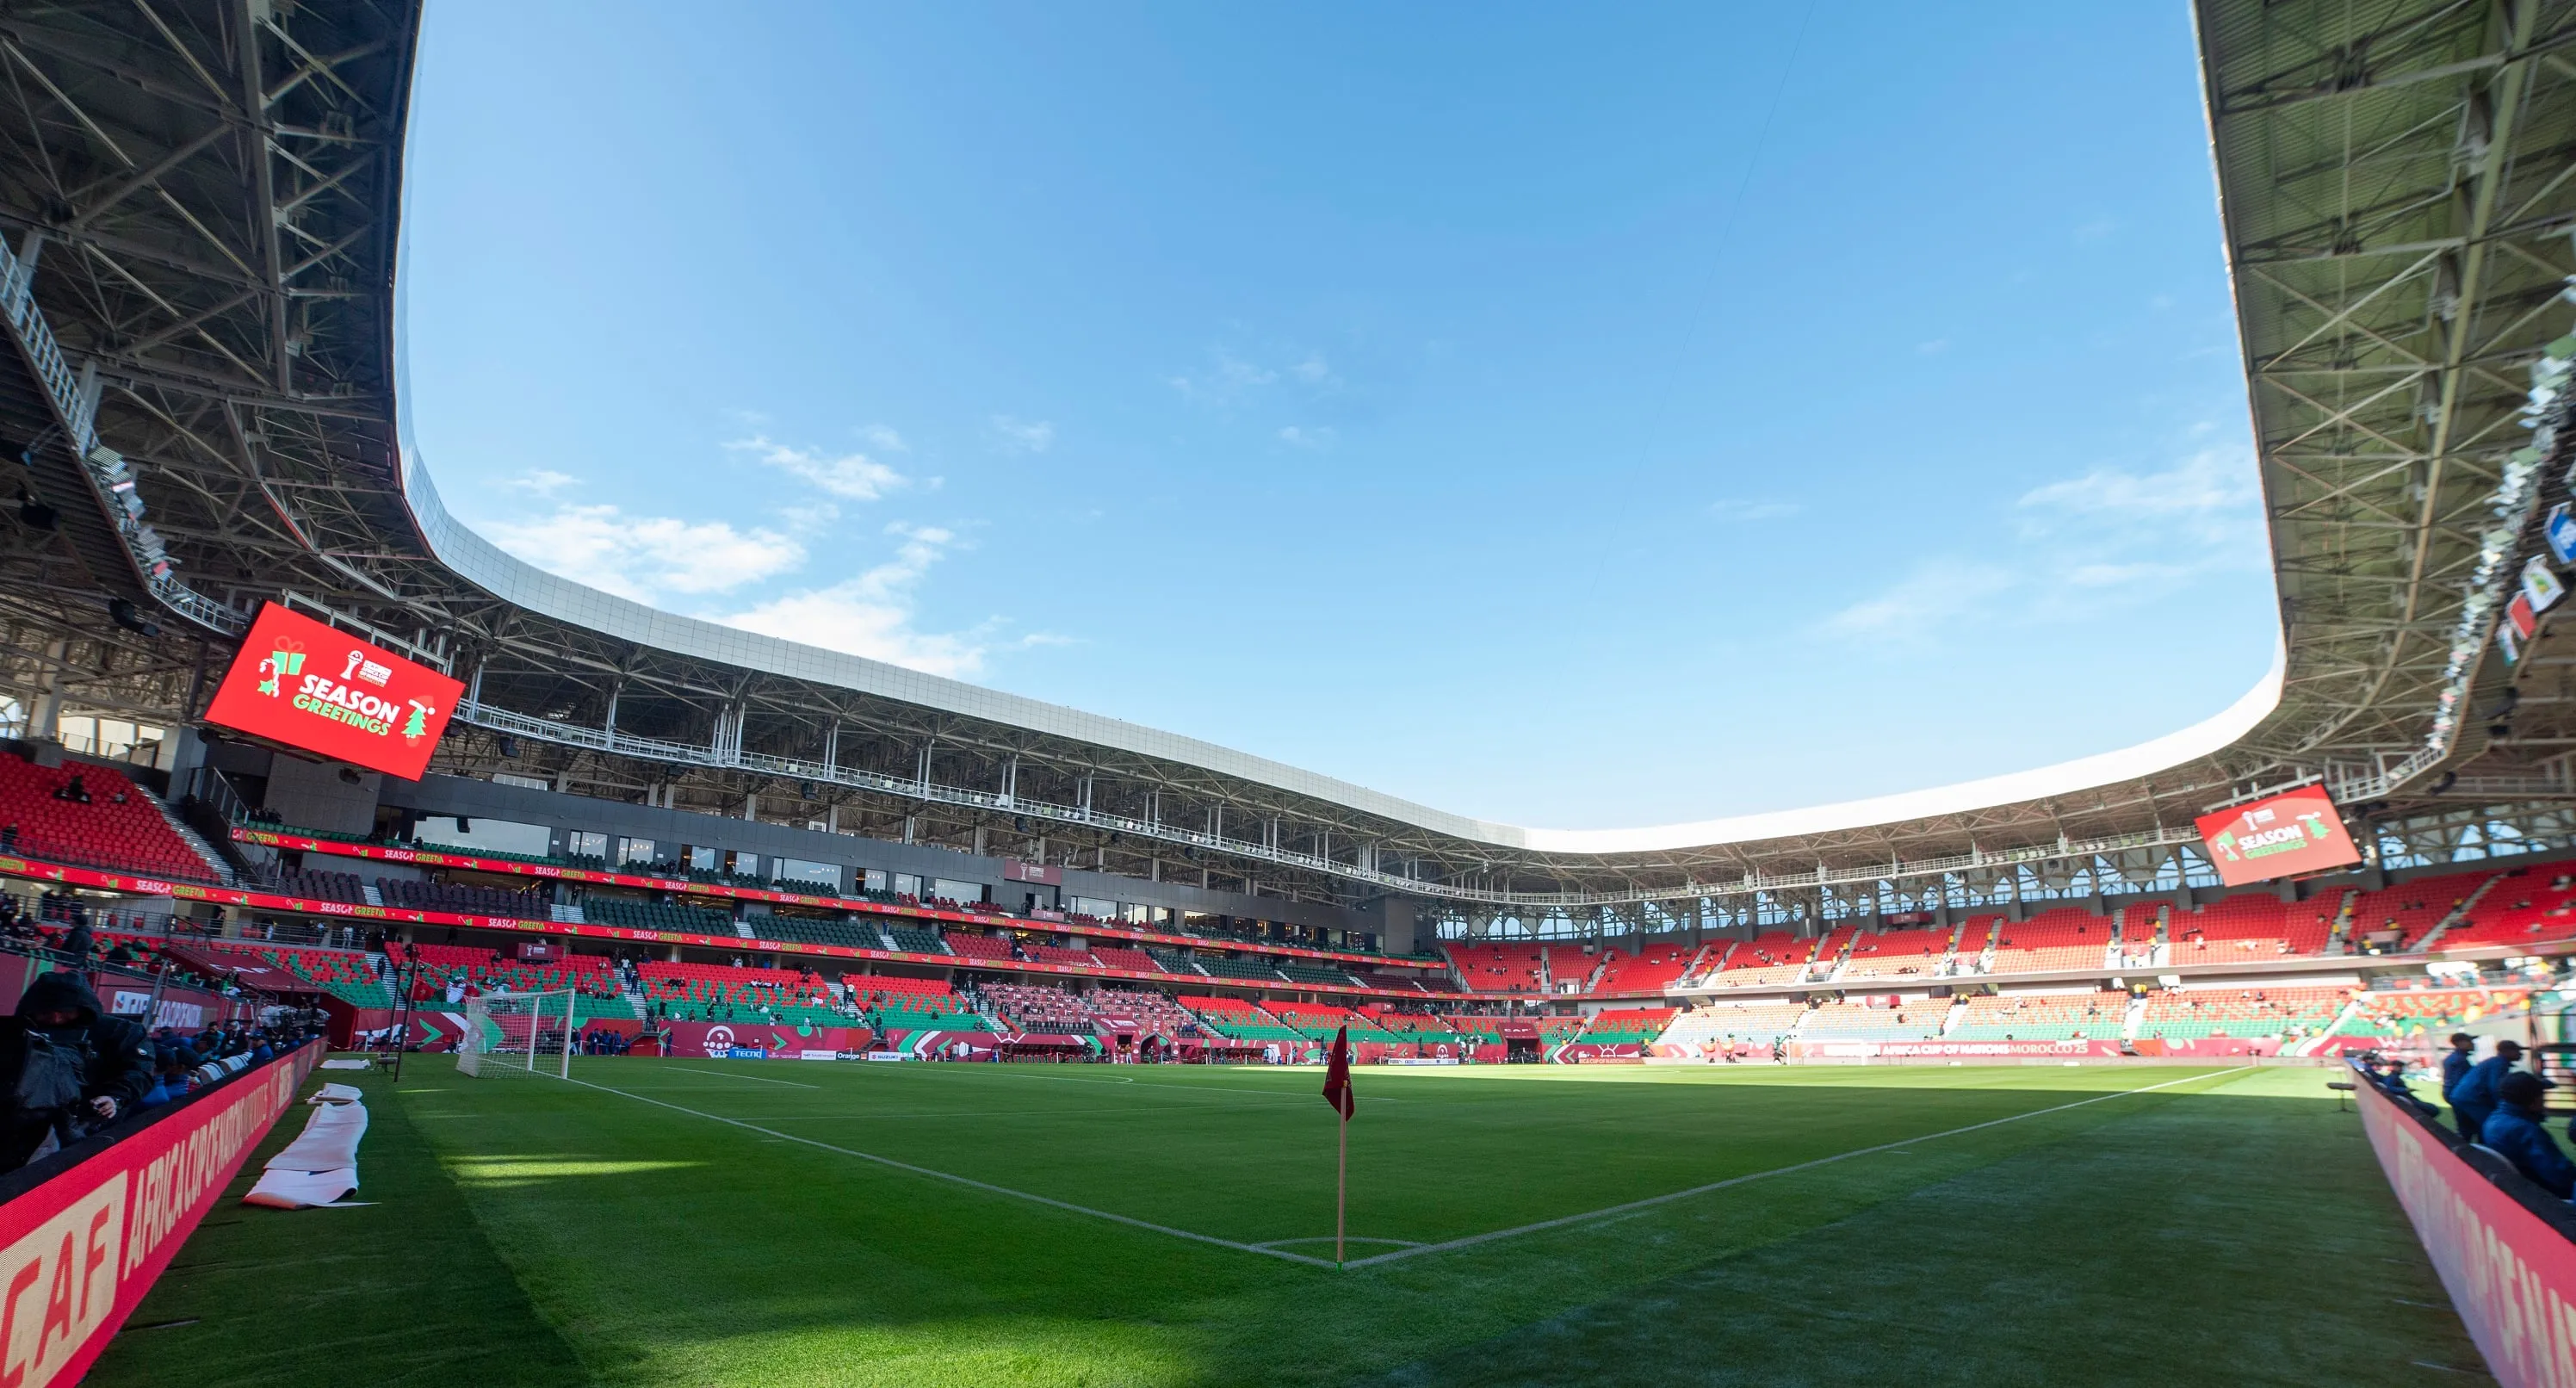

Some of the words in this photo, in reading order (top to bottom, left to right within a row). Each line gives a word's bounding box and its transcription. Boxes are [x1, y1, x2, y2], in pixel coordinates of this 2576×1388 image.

[293, 694, 392, 736] GREETINGS
[299, 674, 400, 724] SEASON
[2238, 824, 2304, 851] SEASON
[1921, 1044, 1943, 1055] CUP
[1943, 1044, 1960, 1054] OF
[2009, 1044, 2071, 1054] MOROCCO
[2074, 1044, 2089, 1054] 25
[0, 1203, 109, 1388] CAF
[124, 1140, 187, 1281] AFRICA
